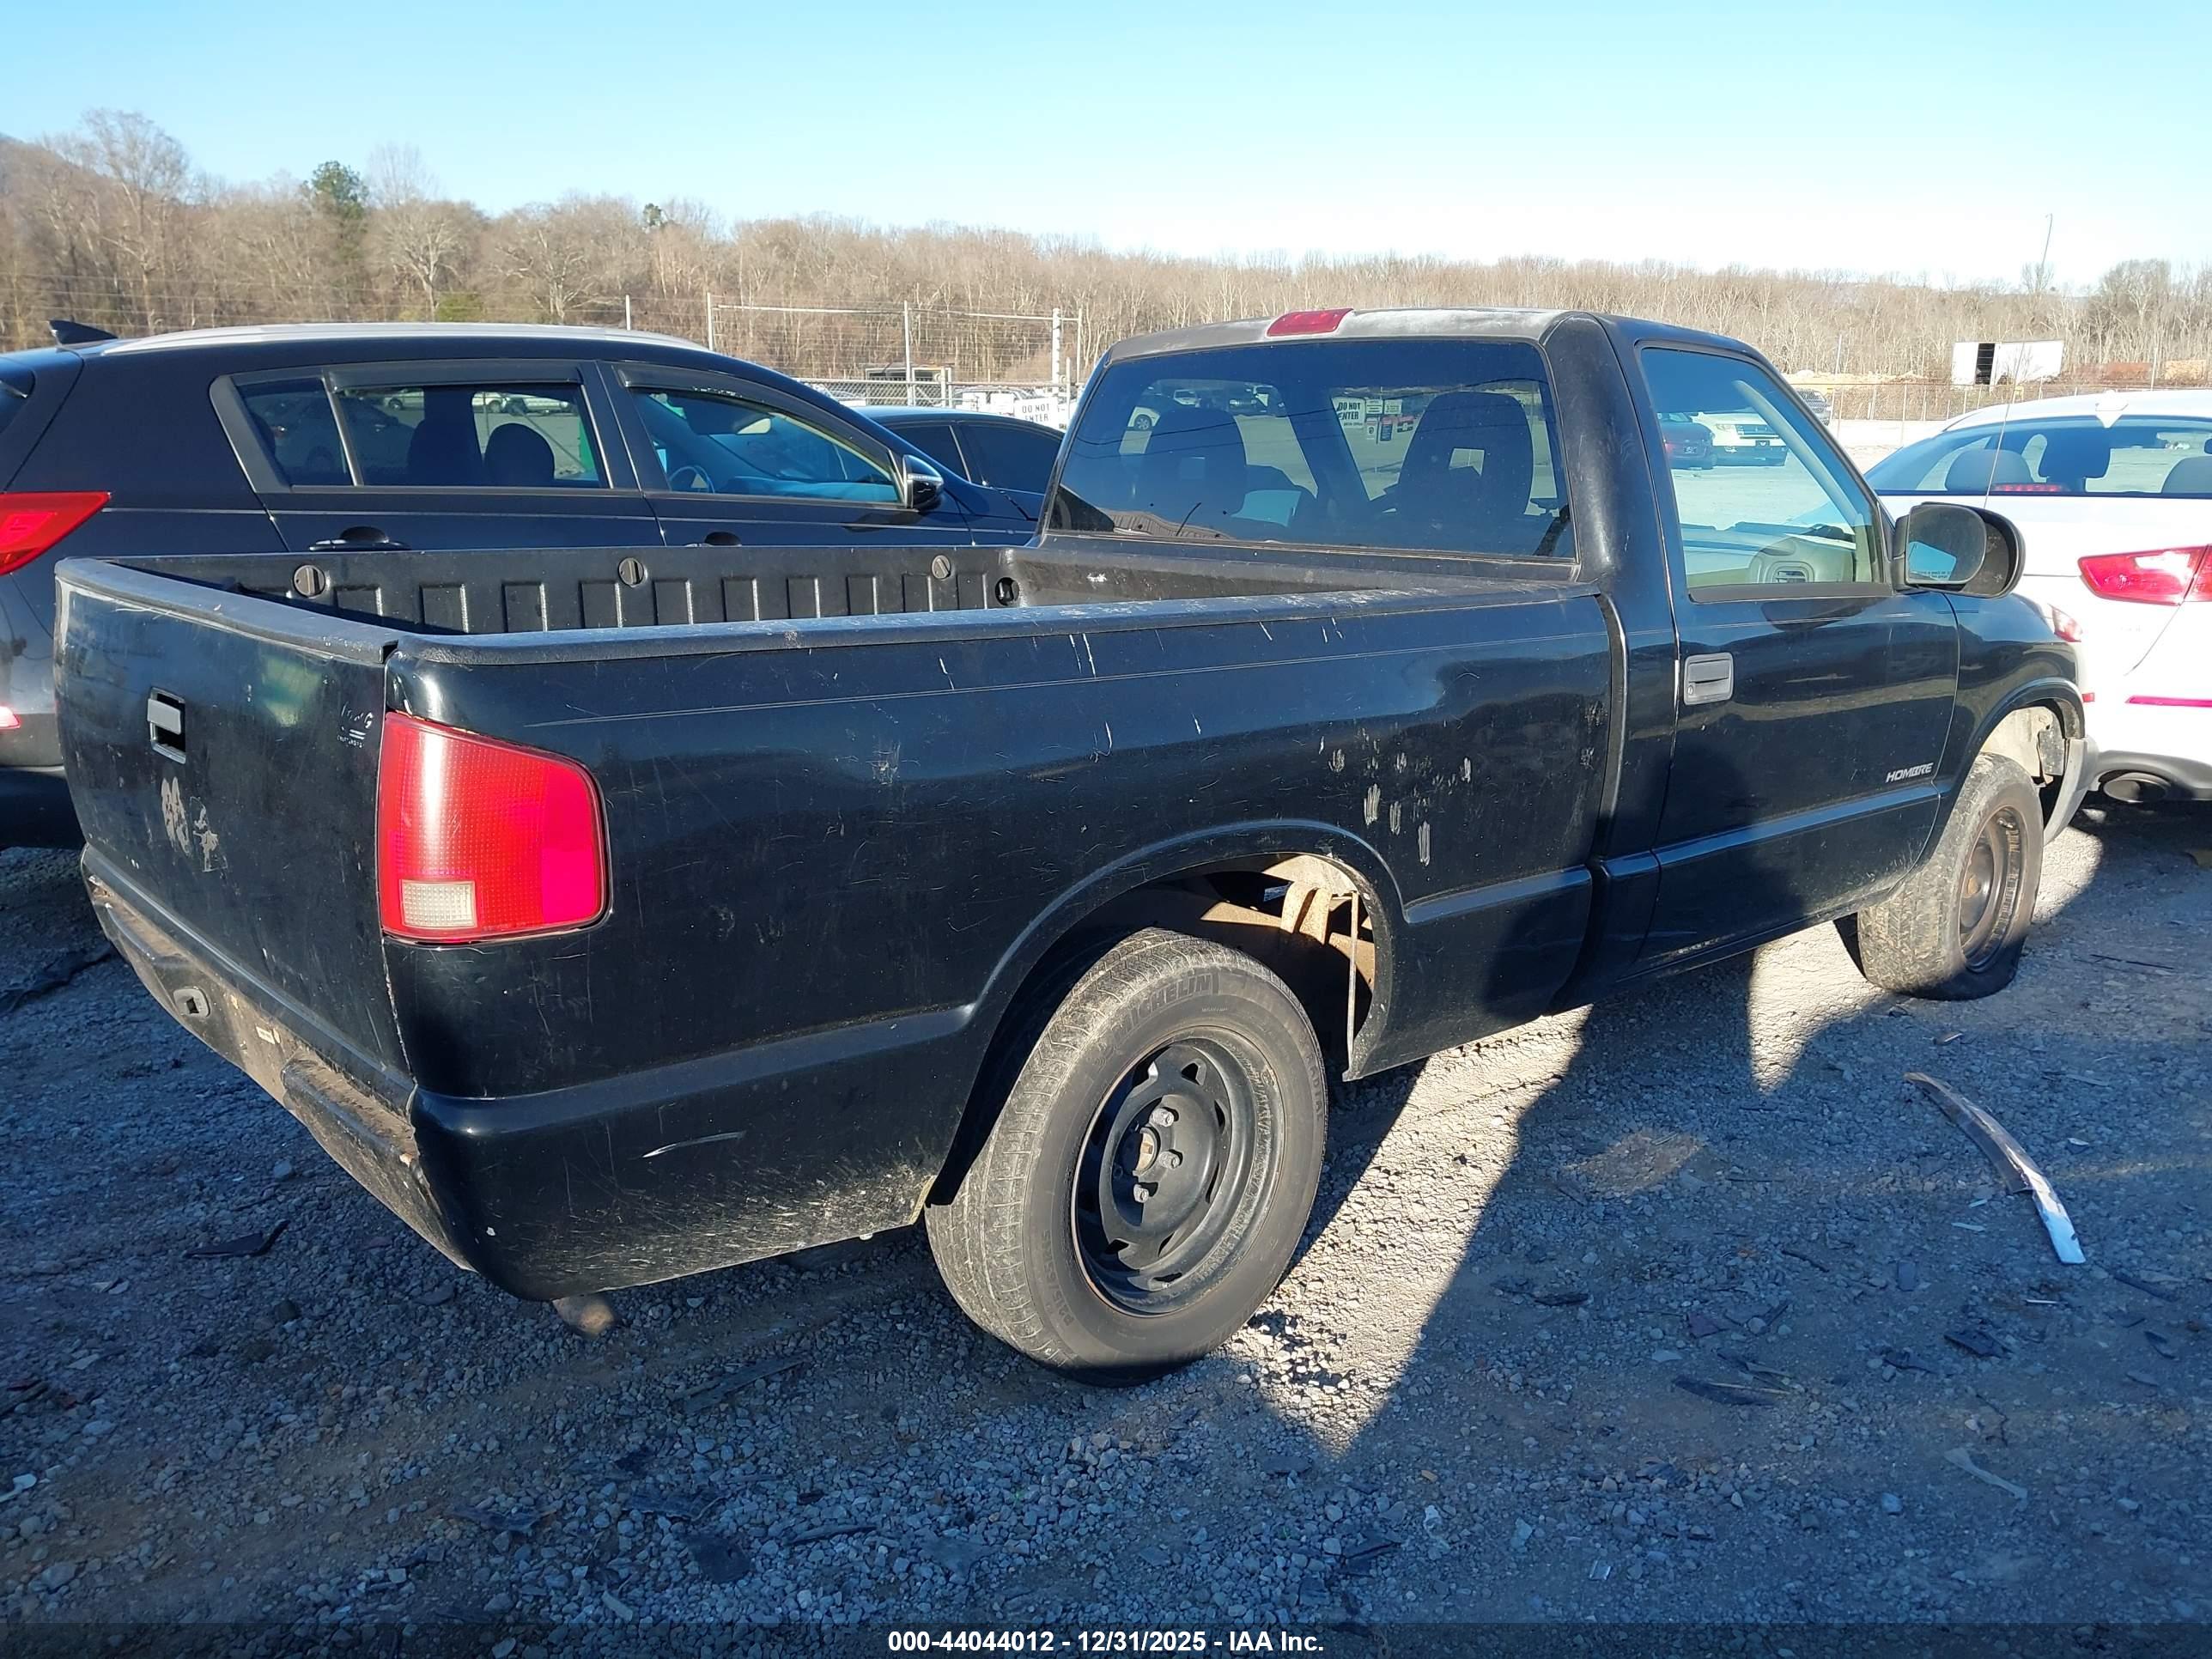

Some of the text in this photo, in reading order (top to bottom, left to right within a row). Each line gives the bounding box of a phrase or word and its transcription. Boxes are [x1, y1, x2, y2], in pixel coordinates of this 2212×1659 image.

[1035, 404, 1049, 412] NOT
[1336, 402, 1347, 411] DO
[1348, 402, 1361, 410] NOT
[1338, 411, 1359, 420] ENTER
[1885, 762, 1934, 783] HOMBRE
[1111, 972, 1213, 1041] MICHELIN
